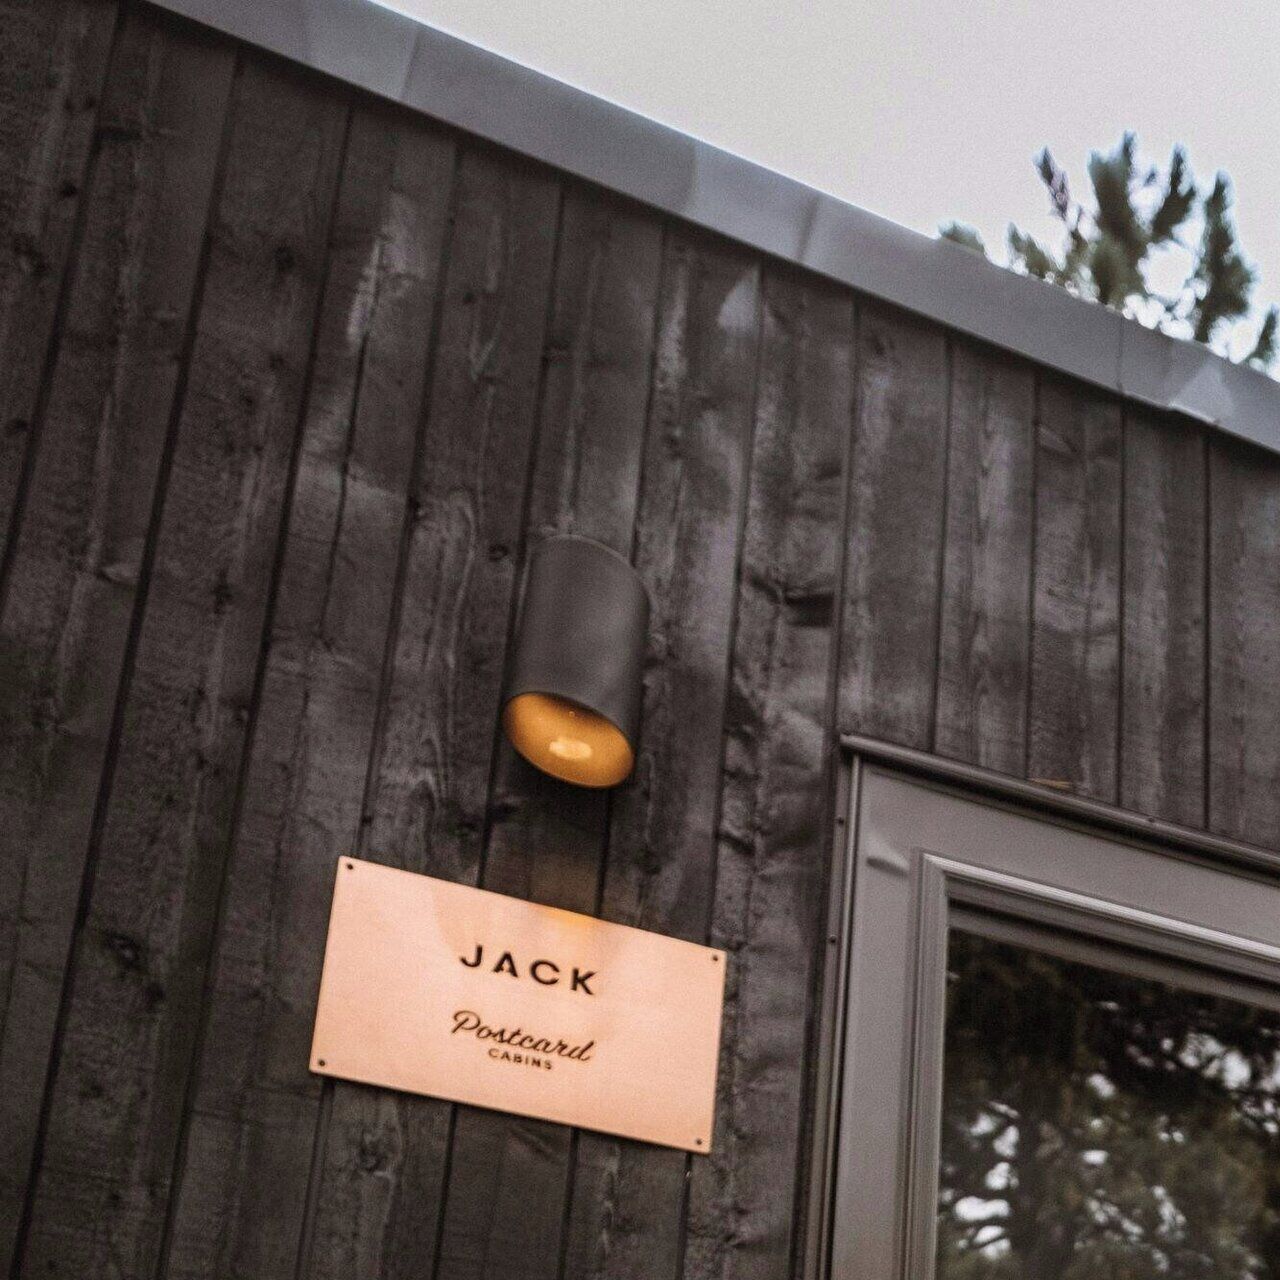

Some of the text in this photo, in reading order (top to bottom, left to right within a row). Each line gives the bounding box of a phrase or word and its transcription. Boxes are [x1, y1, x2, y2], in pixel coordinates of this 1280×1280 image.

[459, 944, 597, 995] JACK
[451, 1009, 595, 1062] Postcard
[487, 1047, 553, 1070] CABINS
